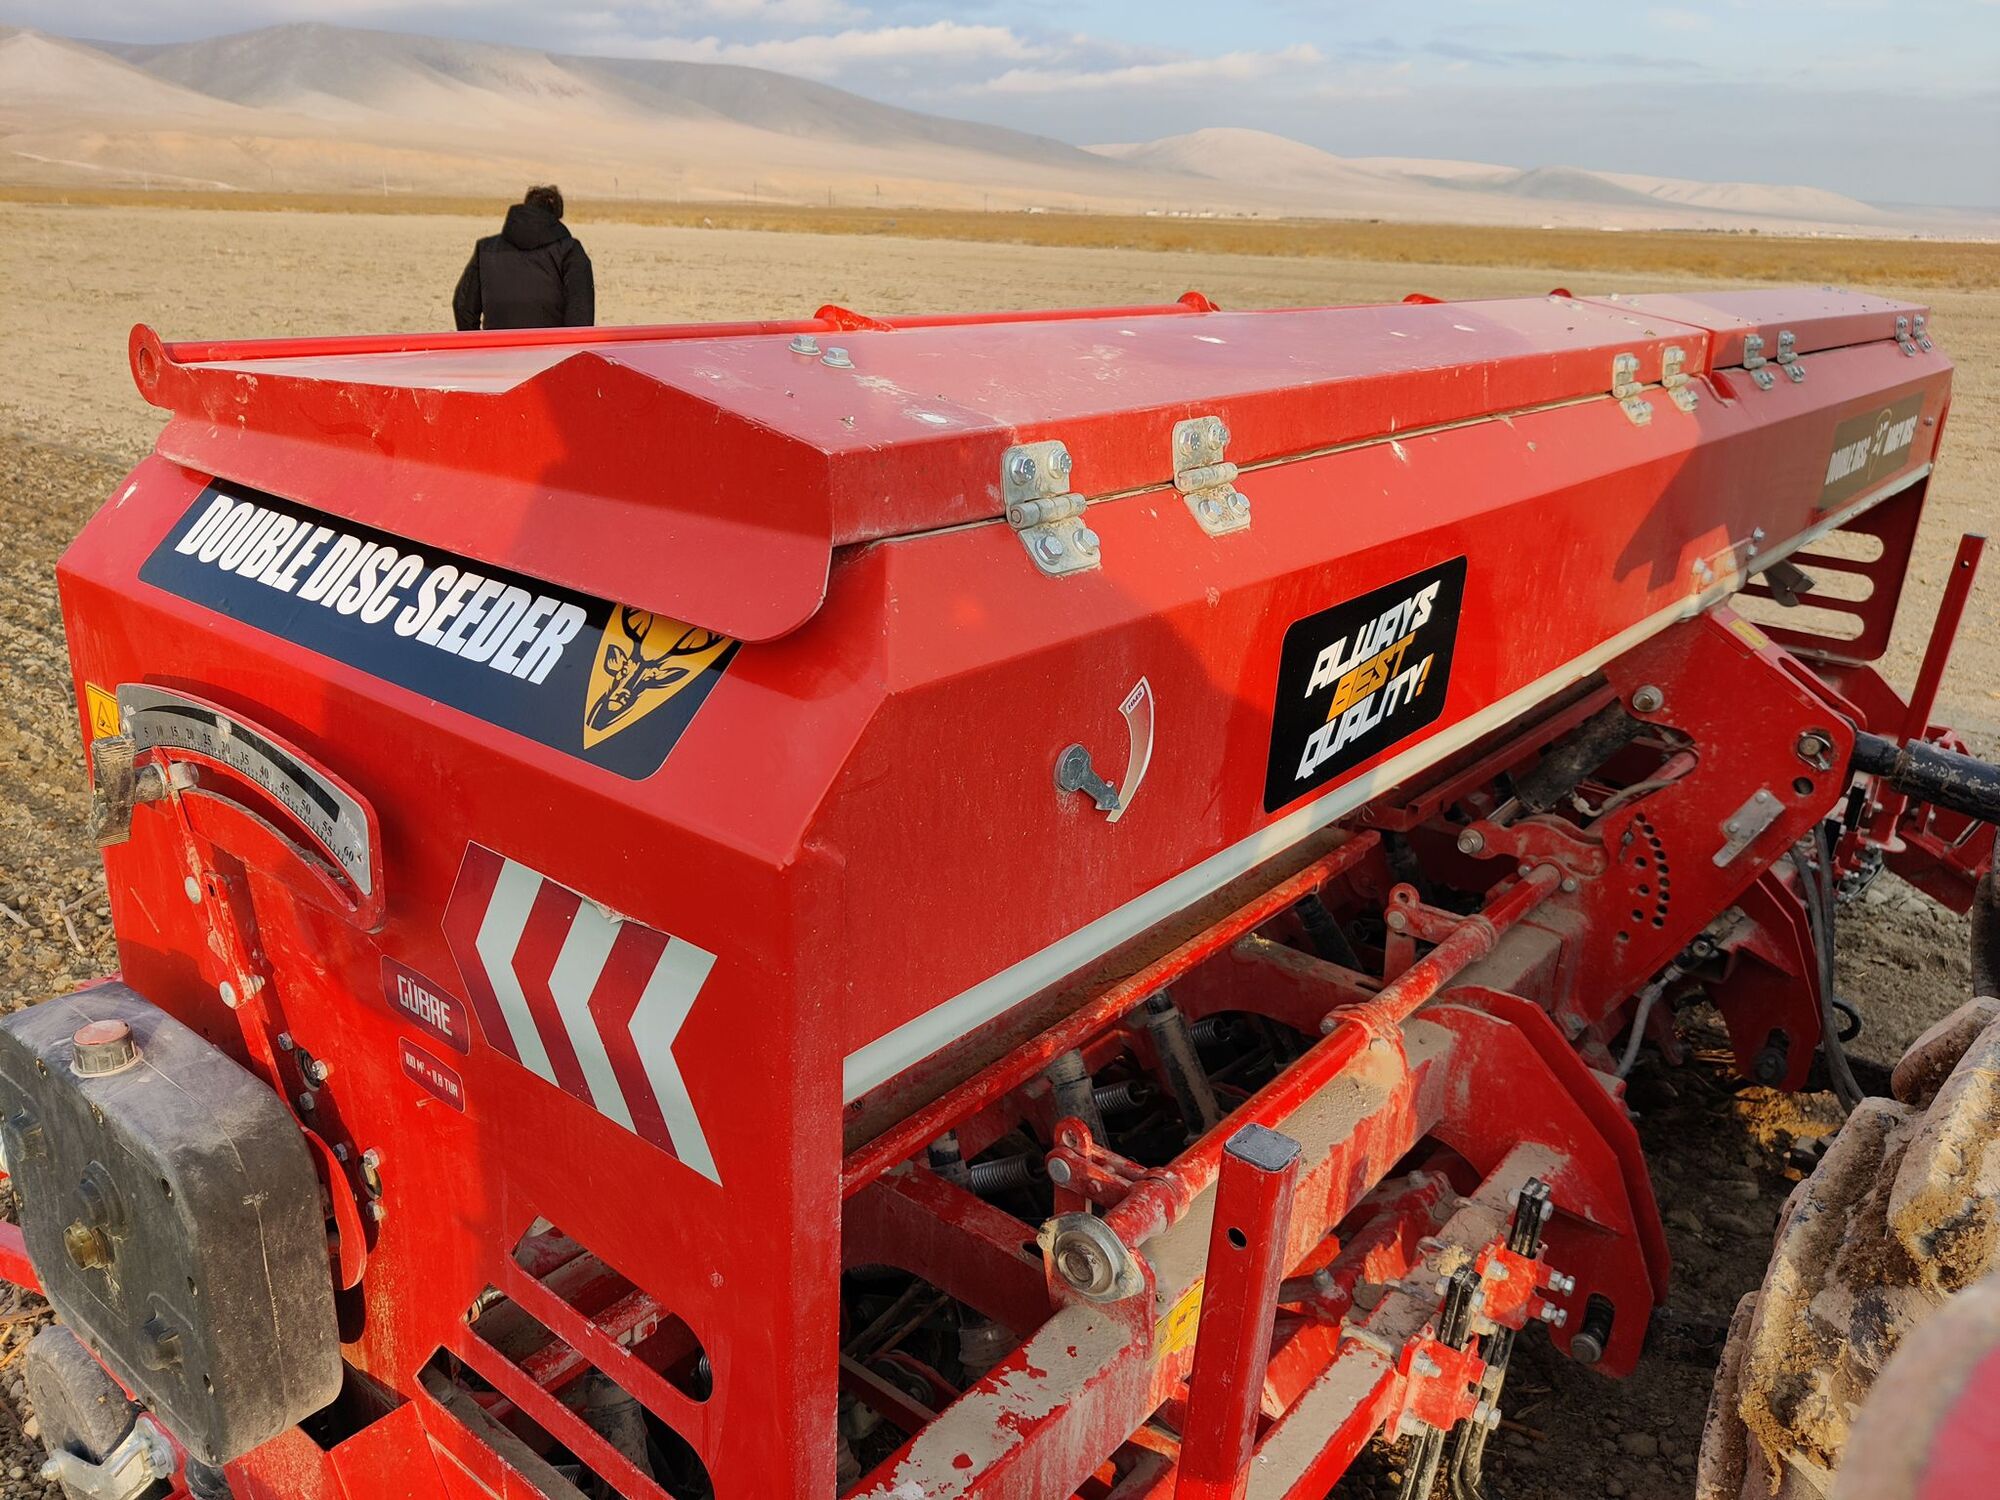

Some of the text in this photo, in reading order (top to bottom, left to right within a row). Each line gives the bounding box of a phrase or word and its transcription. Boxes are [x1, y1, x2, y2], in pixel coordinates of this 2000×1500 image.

[175, 494, 587, 685] DOUBLE DISC SEEDER
[1304, 580, 1441, 698] ALWAYS
[1295, 653, 1434, 781] QUALITY!
[1326, 630, 1416, 722] BEST
[156, 726, 164, 737] 10
[170, 726, 179, 737] 15
[186, 728, 195, 740] 20
[203, 733, 212, 745] 25
[221, 740, 231, 754] 30
[240, 751, 250, 765] 35
[259, 765, 269, 779] 40
[280, 781, 290, 795] 45
[301, 800, 311, 815] 50
[322, 821, 333, 837] 55
[344, 846, 354, 862] 60
[397, 974, 452, 1036] GÜBRE
[444, 1077, 458, 1097] TUR
